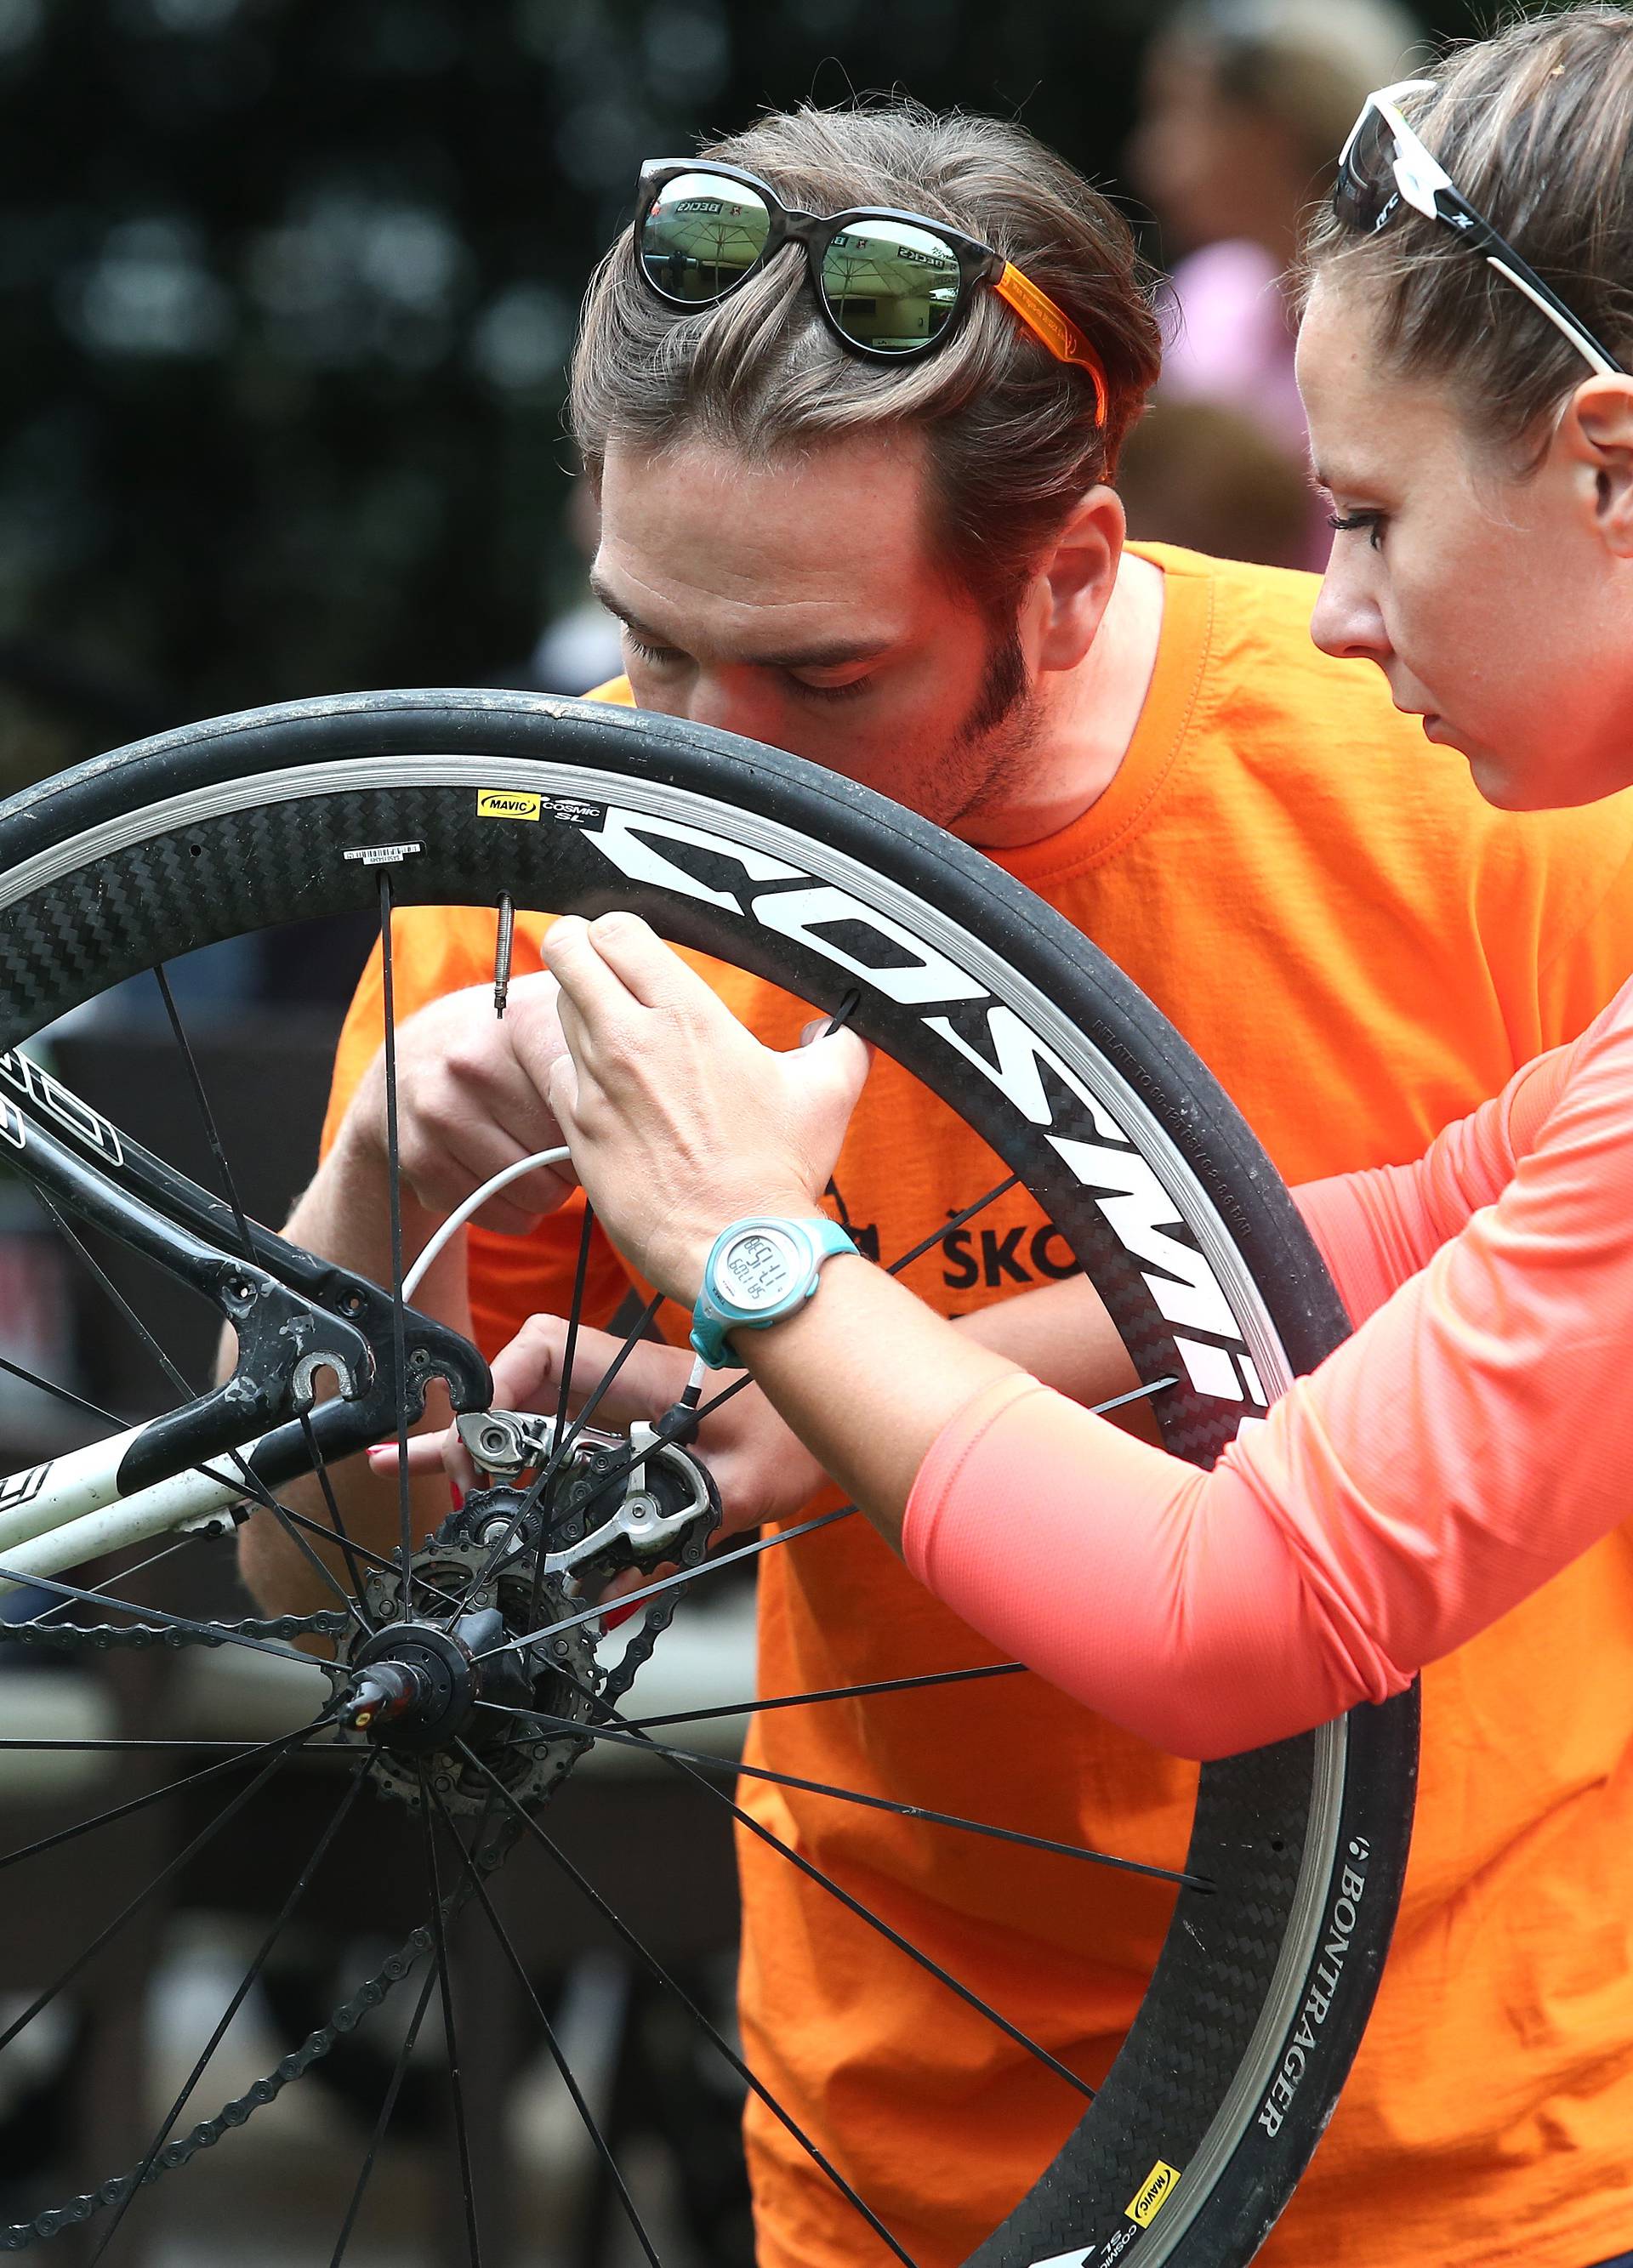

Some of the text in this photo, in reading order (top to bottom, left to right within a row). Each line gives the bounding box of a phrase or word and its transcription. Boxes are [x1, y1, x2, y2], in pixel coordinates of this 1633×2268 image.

[489, 799, 528, 811] MAVIC
[542, 801, 600, 816] COSMIC
[554, 812, 585, 823] SL
[1091, 1019, 1137, 1066] INFLATE
[1135, 1066, 1152, 1086] TO
[1232, 1204, 1252, 1236] BAR
[1258, 1863, 1365, 2138] BONTRAGER
[1139, 2174, 1166, 2212] MAVIC
[1100, 2229, 1123, 2254] SL
